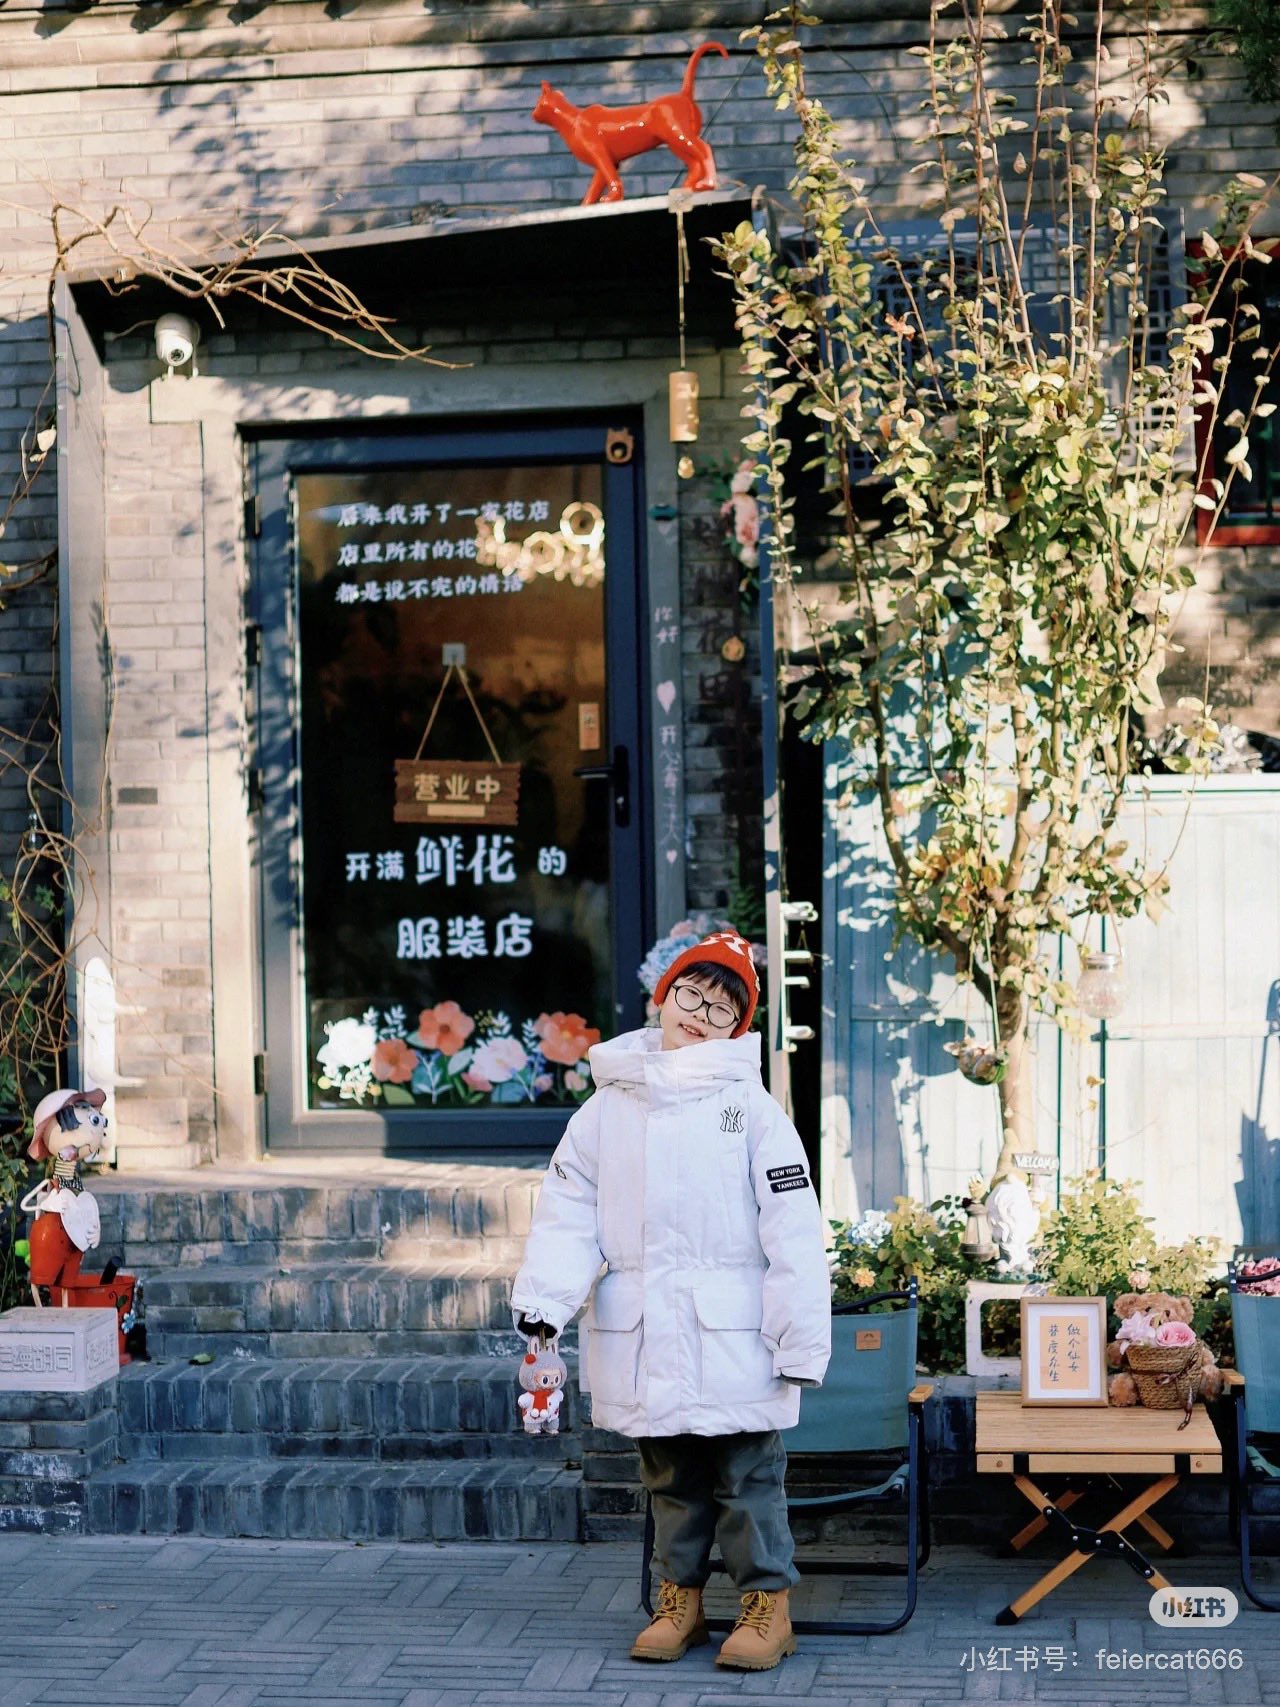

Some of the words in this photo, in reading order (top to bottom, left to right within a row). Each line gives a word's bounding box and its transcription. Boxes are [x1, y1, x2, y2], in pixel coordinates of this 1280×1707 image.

[414, 773, 501, 802] 营业中
[396, 912, 534, 958] 服装店
[770, 1170, 785, 1179] NEW
[785, 1166, 801, 1176] YORK
[776, 1180, 805, 1191] YANKEES
[1067, 1323, 1081, 1373] 做个仙女
